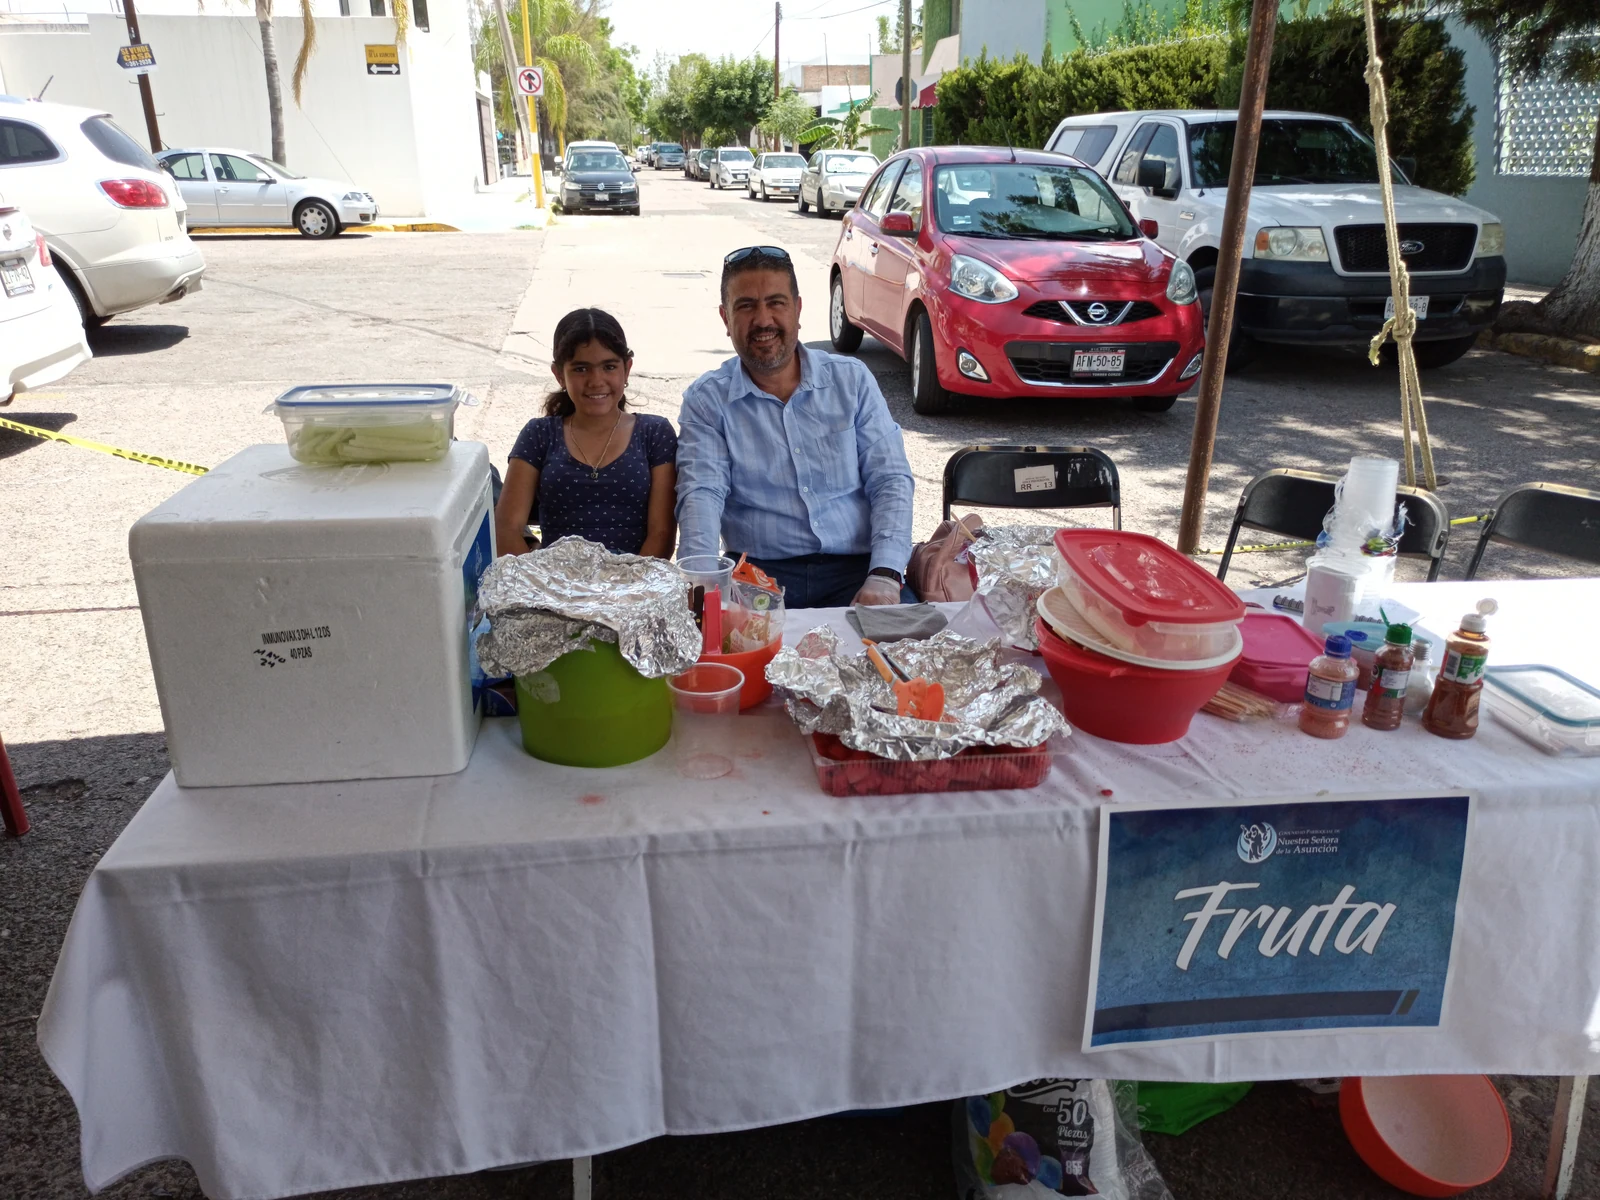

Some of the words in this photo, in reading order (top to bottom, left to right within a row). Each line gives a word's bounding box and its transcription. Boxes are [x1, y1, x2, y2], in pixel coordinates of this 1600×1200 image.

[121, 48, 129, 56] SE
[129, 45, 150, 54] VENDE
[123, 52, 153, 62] CASA
[1401, 243, 1417, 252] Ford
[1076, 355, 1122, 368] AFN-50-85
[1020, 483, 1032, 491] RR
[1044, 481, 1053, 489] 13
[261, 629, 297, 645] INMUNOVAX
[296, 629, 302, 641] 3
[315, 626, 323, 638] 12
[322, 625, 332, 638] DS
[290, 648, 298, 660] 40
[297, 646, 313, 659] PZAS
[260, 657, 275, 668] 24
[1277, 837, 1310, 846] Nuestra
[1311, 836, 1339, 845] Señora
[1293, 844, 1338, 854] Asunción
[1174, 881, 1397, 971] Fruta
[1057, 1098, 1088, 1126] 50
[1057, 1125, 1089, 1139] Piezas
[1065, 1160, 1083, 1176] 855
